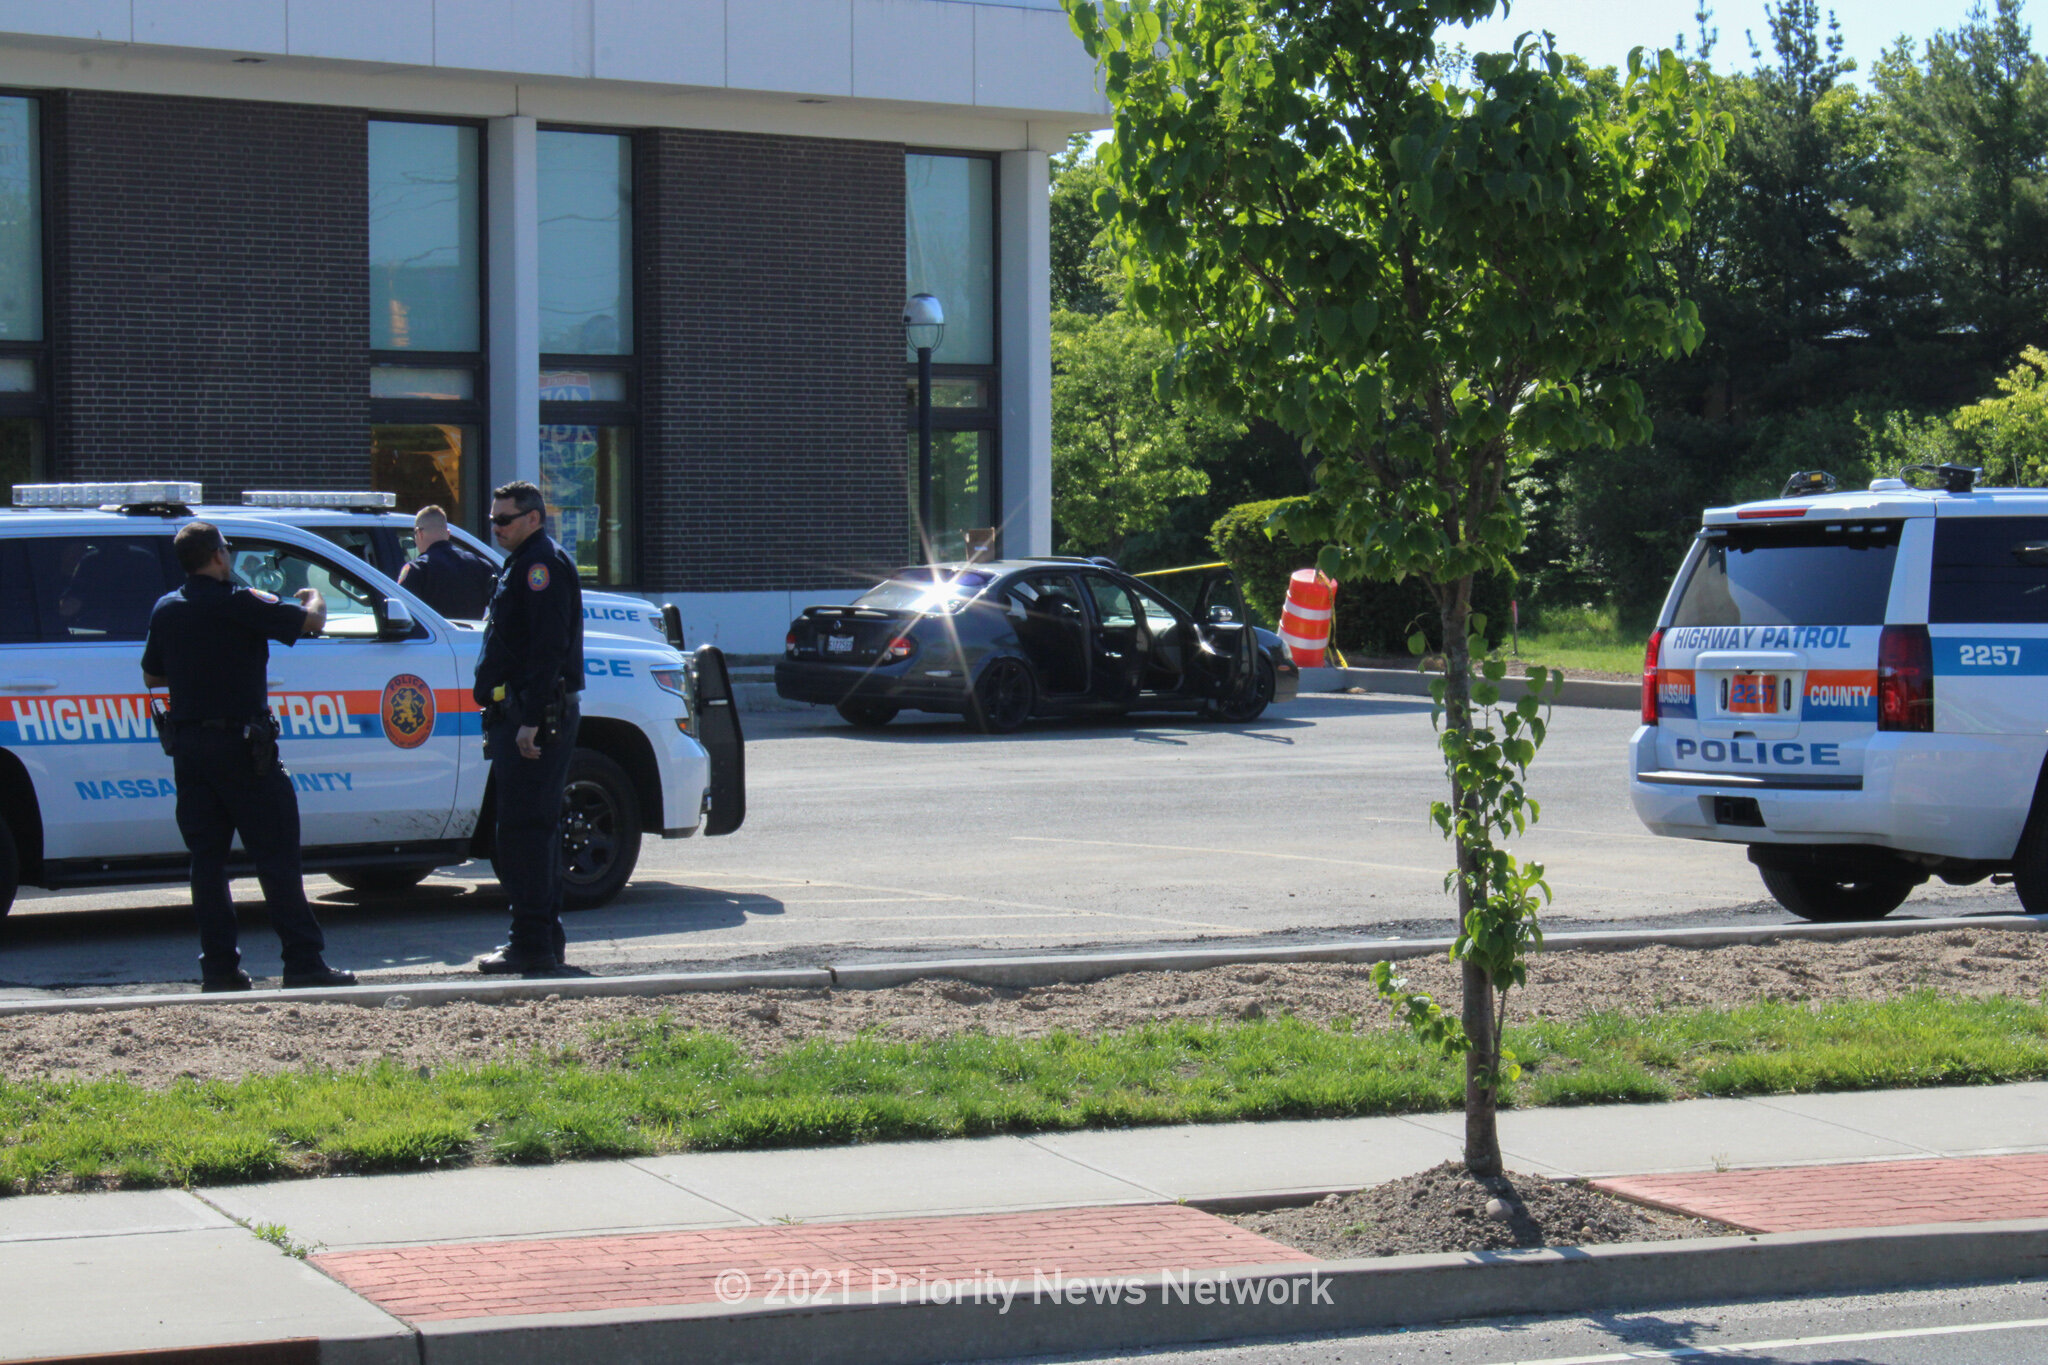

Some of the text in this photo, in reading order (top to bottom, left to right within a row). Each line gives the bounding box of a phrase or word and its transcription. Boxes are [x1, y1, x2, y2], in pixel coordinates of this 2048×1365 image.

[583, 607, 641, 622] LICE
[1673, 626, 1852, 649] HIGHWAY PATROL
[1959, 644, 2021, 666] 2257
[1658, 683, 1873, 707] NASSAU COUNTY
[1732, 684, 1776, 704] 2257
[11, 696, 167, 741] HIGHW
[268, 695, 361, 735] TROL
[1676, 738, 1840, 766] POLICE
[74, 778, 178, 801] NASSA
